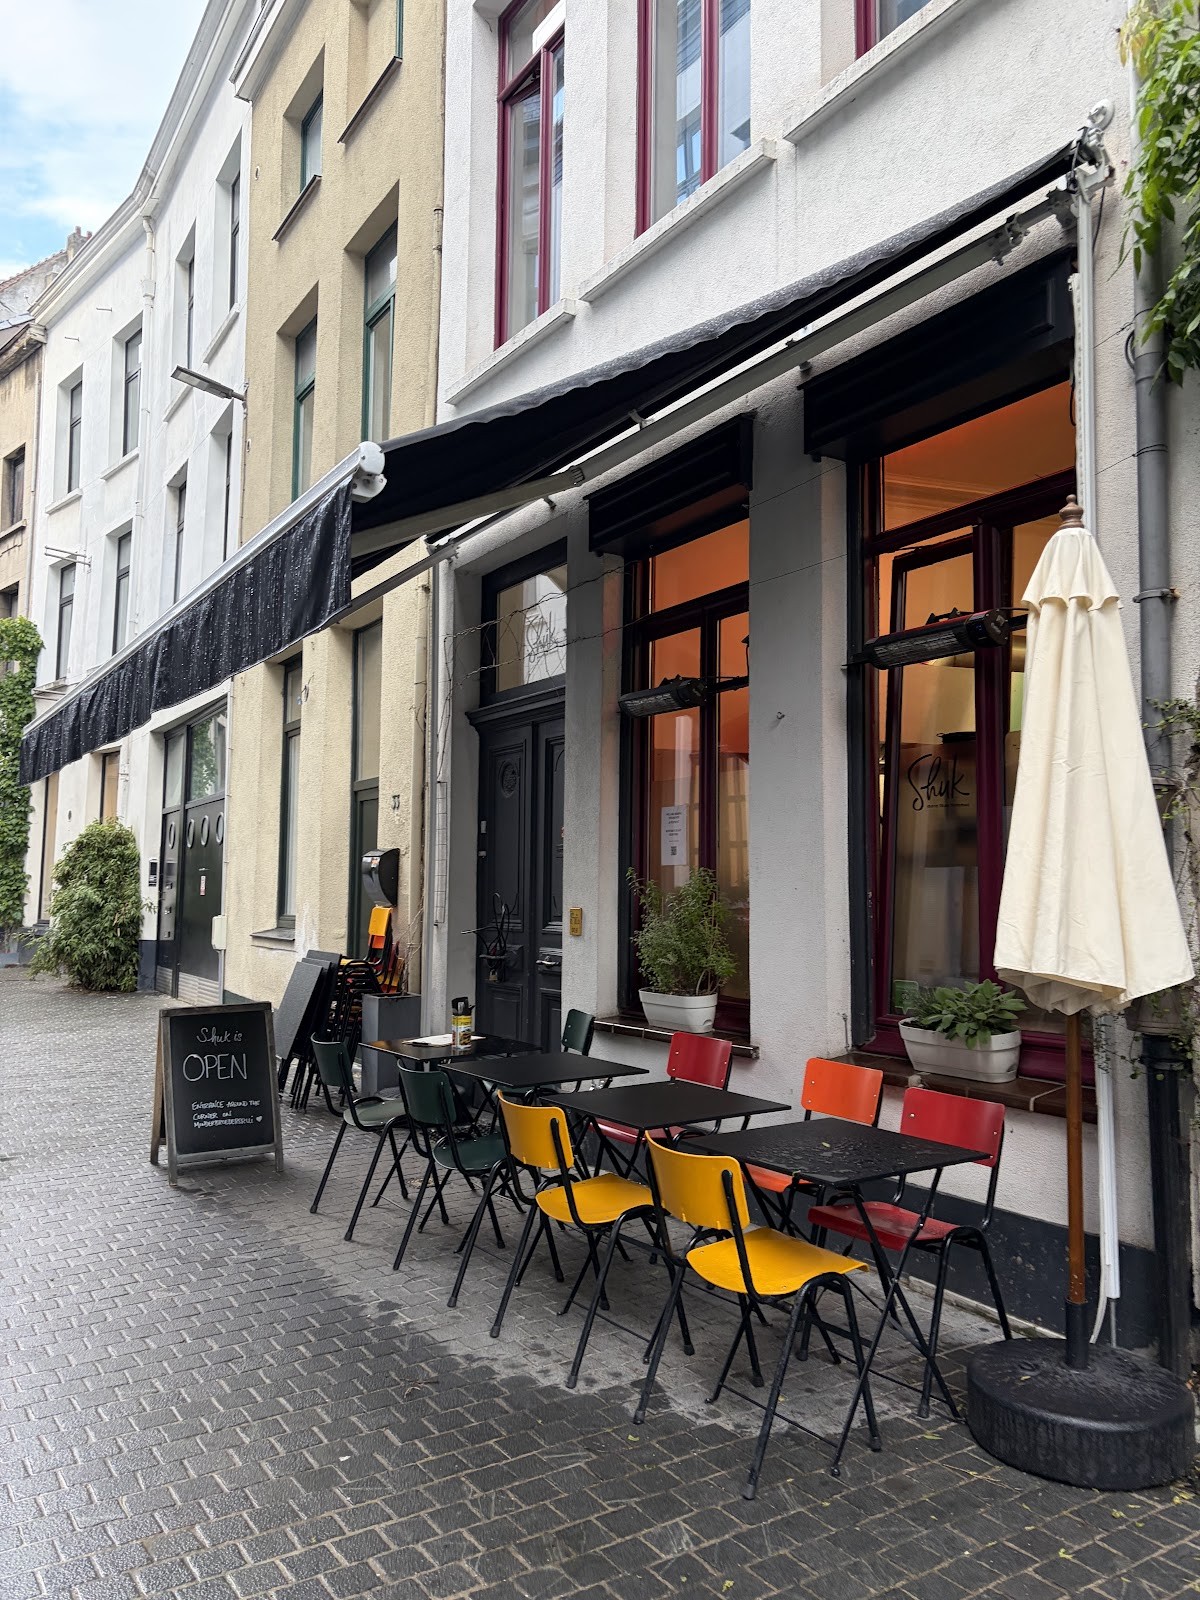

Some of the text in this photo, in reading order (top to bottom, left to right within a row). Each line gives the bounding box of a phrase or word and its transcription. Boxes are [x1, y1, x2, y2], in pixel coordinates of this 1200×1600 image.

[907, 753, 970, 811] Shuk
[196, 1026, 243, 1046] Shuk is
[182, 1053, 248, 1082] OPEN
[191, 1100, 225, 1110] ENTRANCE
